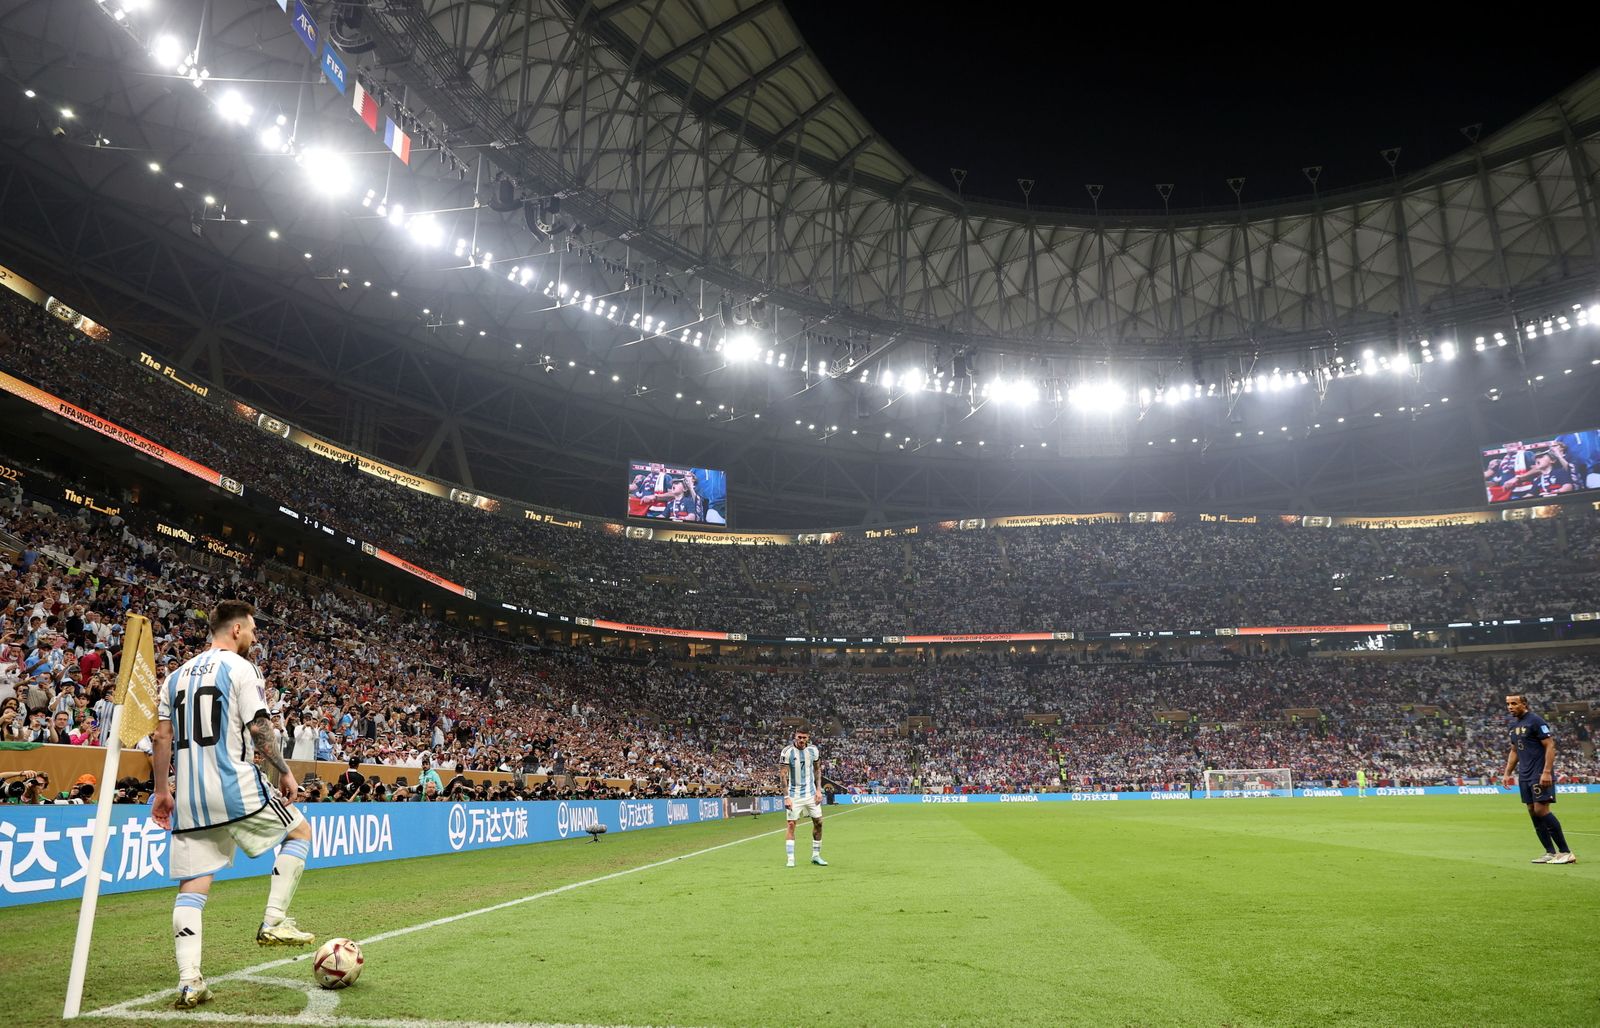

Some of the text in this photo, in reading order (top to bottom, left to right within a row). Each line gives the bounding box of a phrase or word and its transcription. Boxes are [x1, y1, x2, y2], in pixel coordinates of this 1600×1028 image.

[297, 14, 315, 40] AFC
[327, 54, 343, 82] FIFA
[140, 352, 161, 371] The
[60, 404, 76, 417] FIFA
[76, 411, 103, 429] WORLD
[103, 424, 118, 436] CUP
[313, 442, 329, 454] FIFA
[65, 489, 82, 504] The
[525, 510, 541, 521] The
[1200, 514, 1216, 522] The
[157, 523, 172, 537] FIFA
[865, 530, 881, 539] The
[182, 662, 215, 677] MESSI
[173, 686, 223, 750] 10
[1518, 739, 1524, 750] 5
[800, 760, 805, 770] 7
[1533, 784, 1541, 795] 5
[861, 795, 889, 803] WANDA
[569, 806, 599, 832] WANDA
[627, 803, 655, 827] 万达文旅
[672, 803, 688, 821] WANDA
[469, 807, 529, 844] 万达文旅
[311, 813, 393, 858] WANDA
